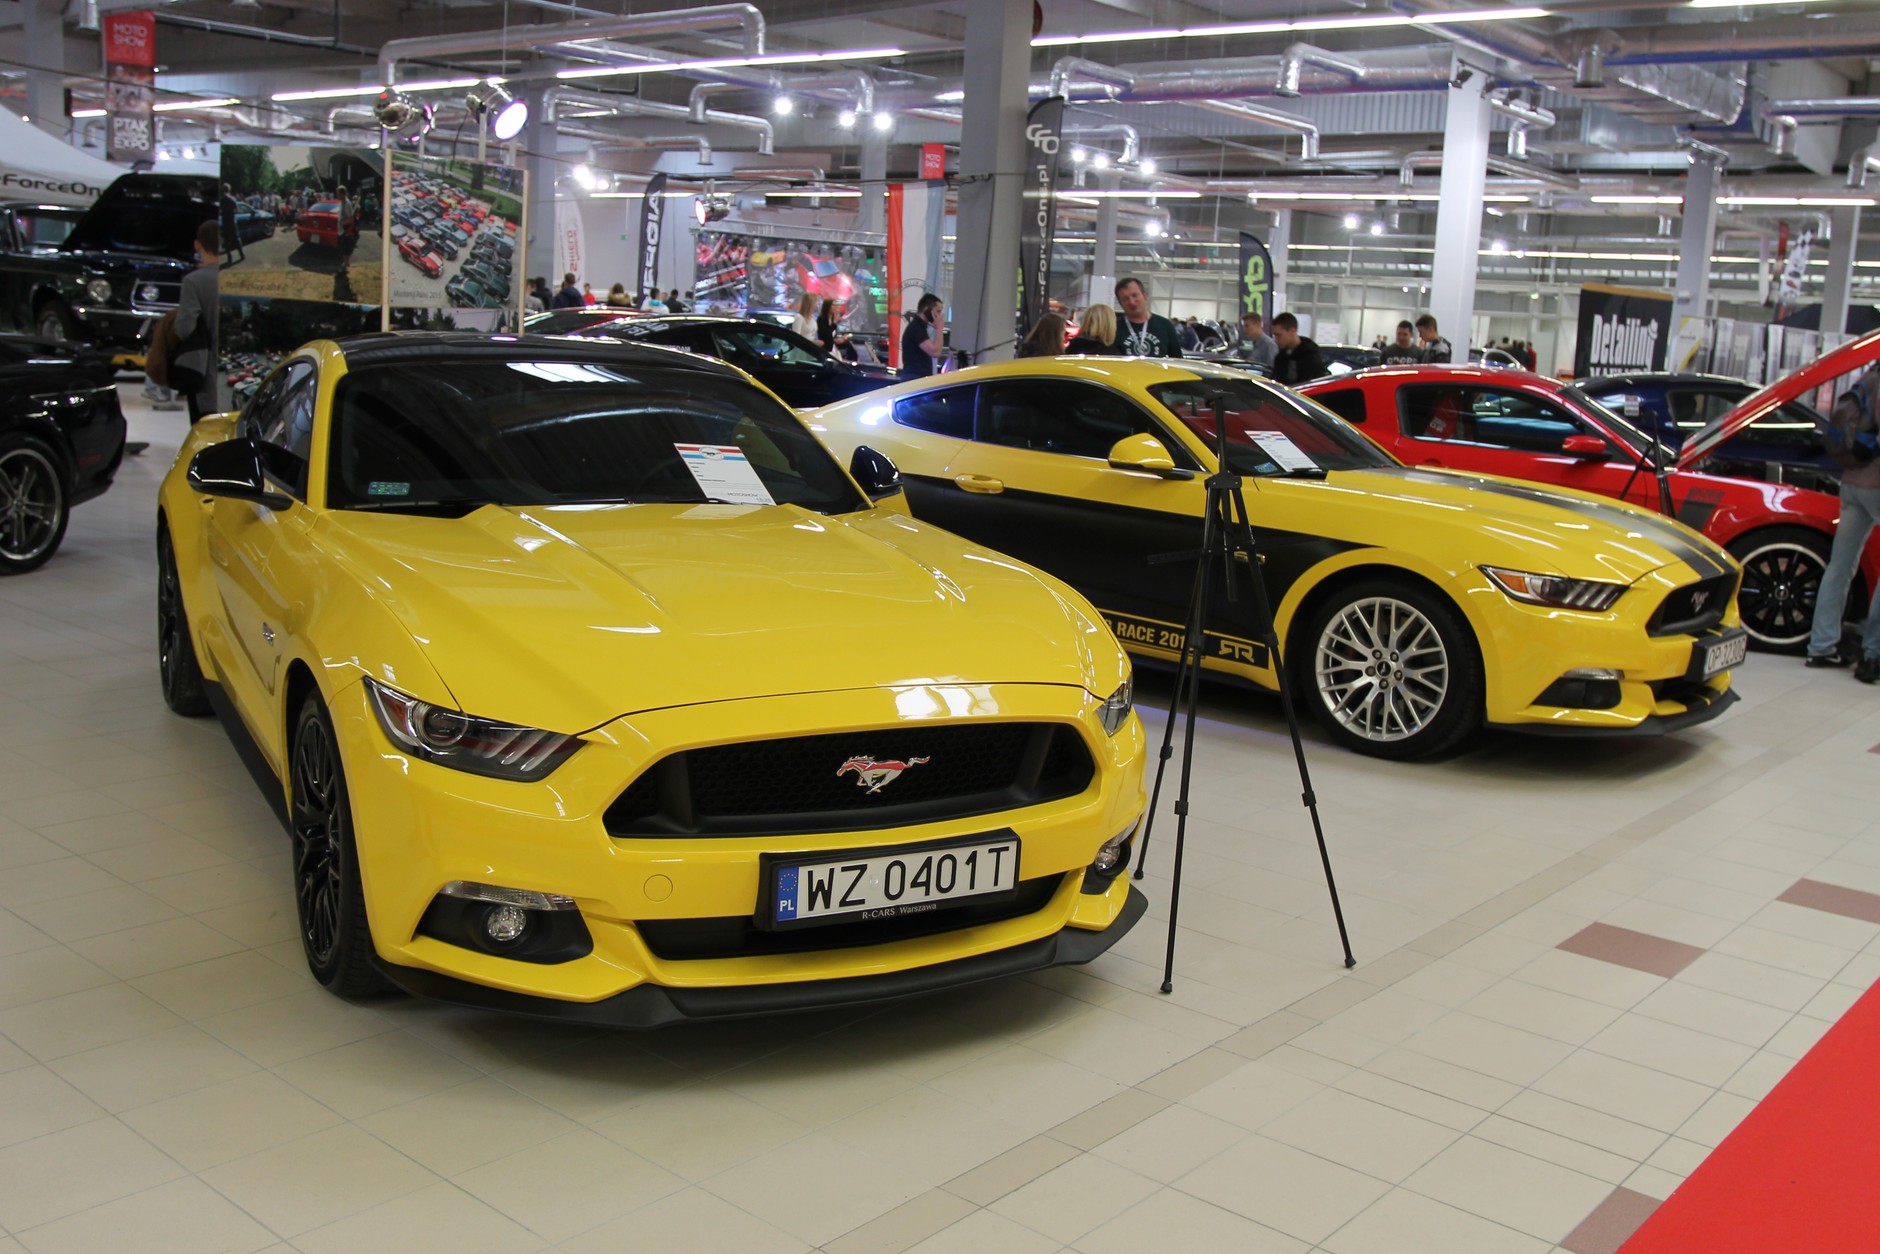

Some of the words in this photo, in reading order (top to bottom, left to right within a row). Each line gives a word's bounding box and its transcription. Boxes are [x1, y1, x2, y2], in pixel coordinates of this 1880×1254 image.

[113, 23, 147, 37] MOTO
[113, 34, 146, 47] SHOW
[113, 117, 148, 131] PTAK
[113, 137, 149, 150] EXPO
[1589, 314, 1658, 372] Detailing
[1117, 621, 1156, 643] RACE
[808, 863, 869, 912] WZ
[883, 846, 1010, 901] 0401T
[779, 900, 795, 912] PL
[861, 908, 896, 919] R-CARS
[899, 903, 937, 915] Warszawa
